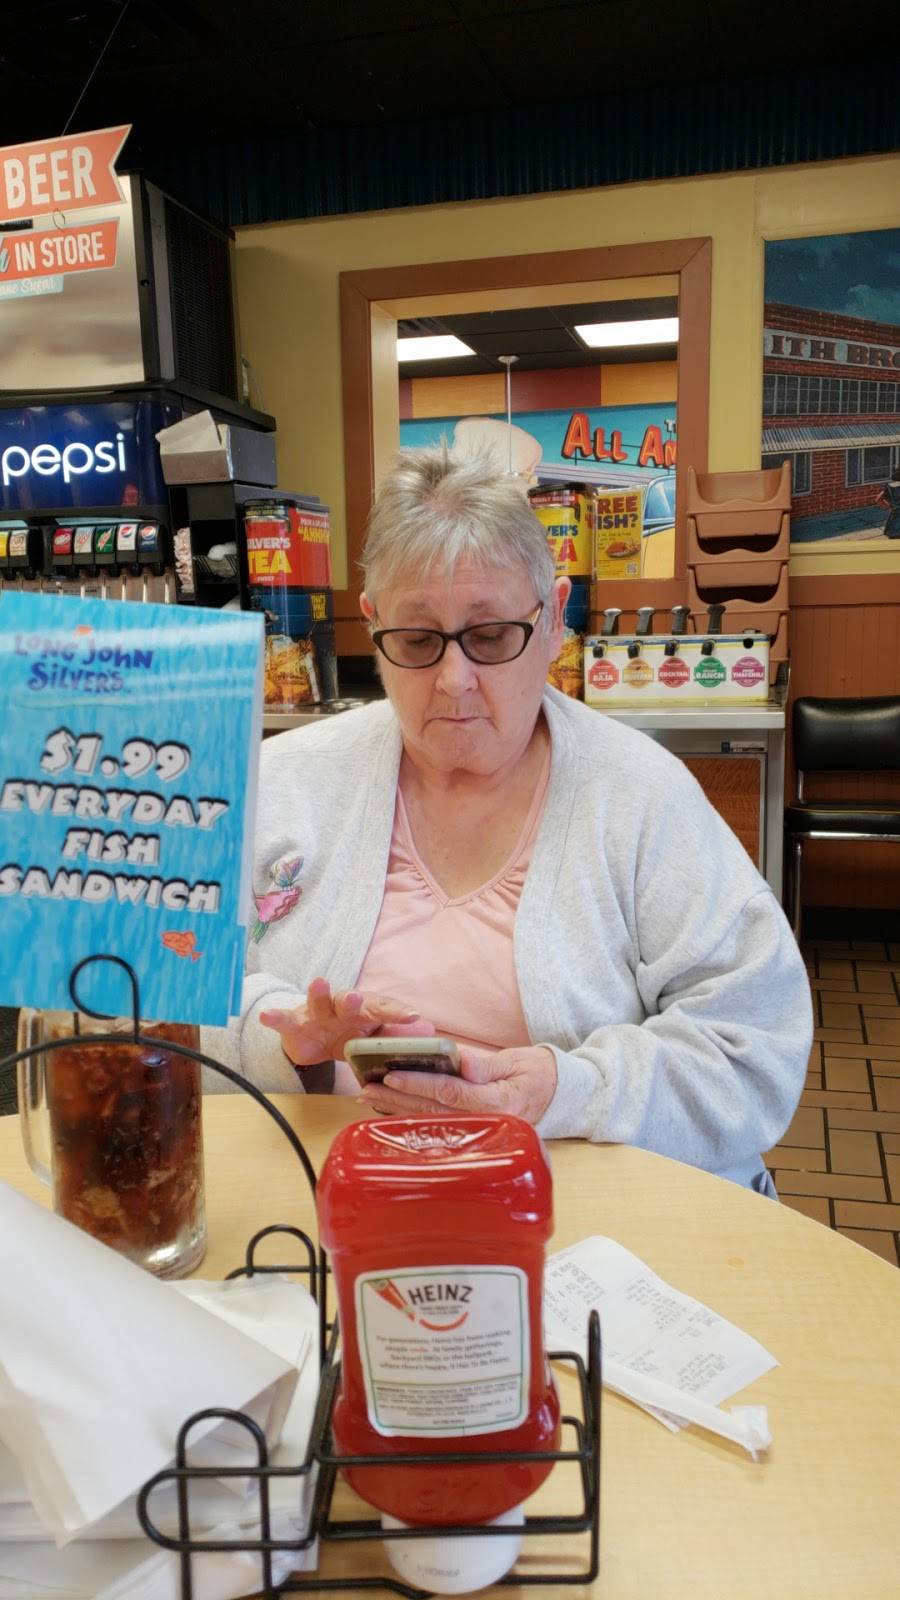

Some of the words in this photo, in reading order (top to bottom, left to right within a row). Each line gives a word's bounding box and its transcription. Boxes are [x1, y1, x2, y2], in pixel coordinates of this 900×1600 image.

[3, 146, 97, 210] BEER
[14, 241, 36, 272] IN
[40, 231, 105, 268] STORE
[561, 410, 628, 463] ALL
[2, 432, 126, 486] pepsi
[596, 495, 638, 514] REE
[596, 513, 639, 531] ISH?
[247, 536, 291, 549] ILVER'S
[247, 549, 292, 574] TEA
[40, 726, 191, 782] $1.99
[0, 778, 229, 831] EVERYDAY
[61, 825, 161, 867] FISH
[0, 863, 221, 914] SANDWICH
[409, 1284, 473, 1306] HEINZ
